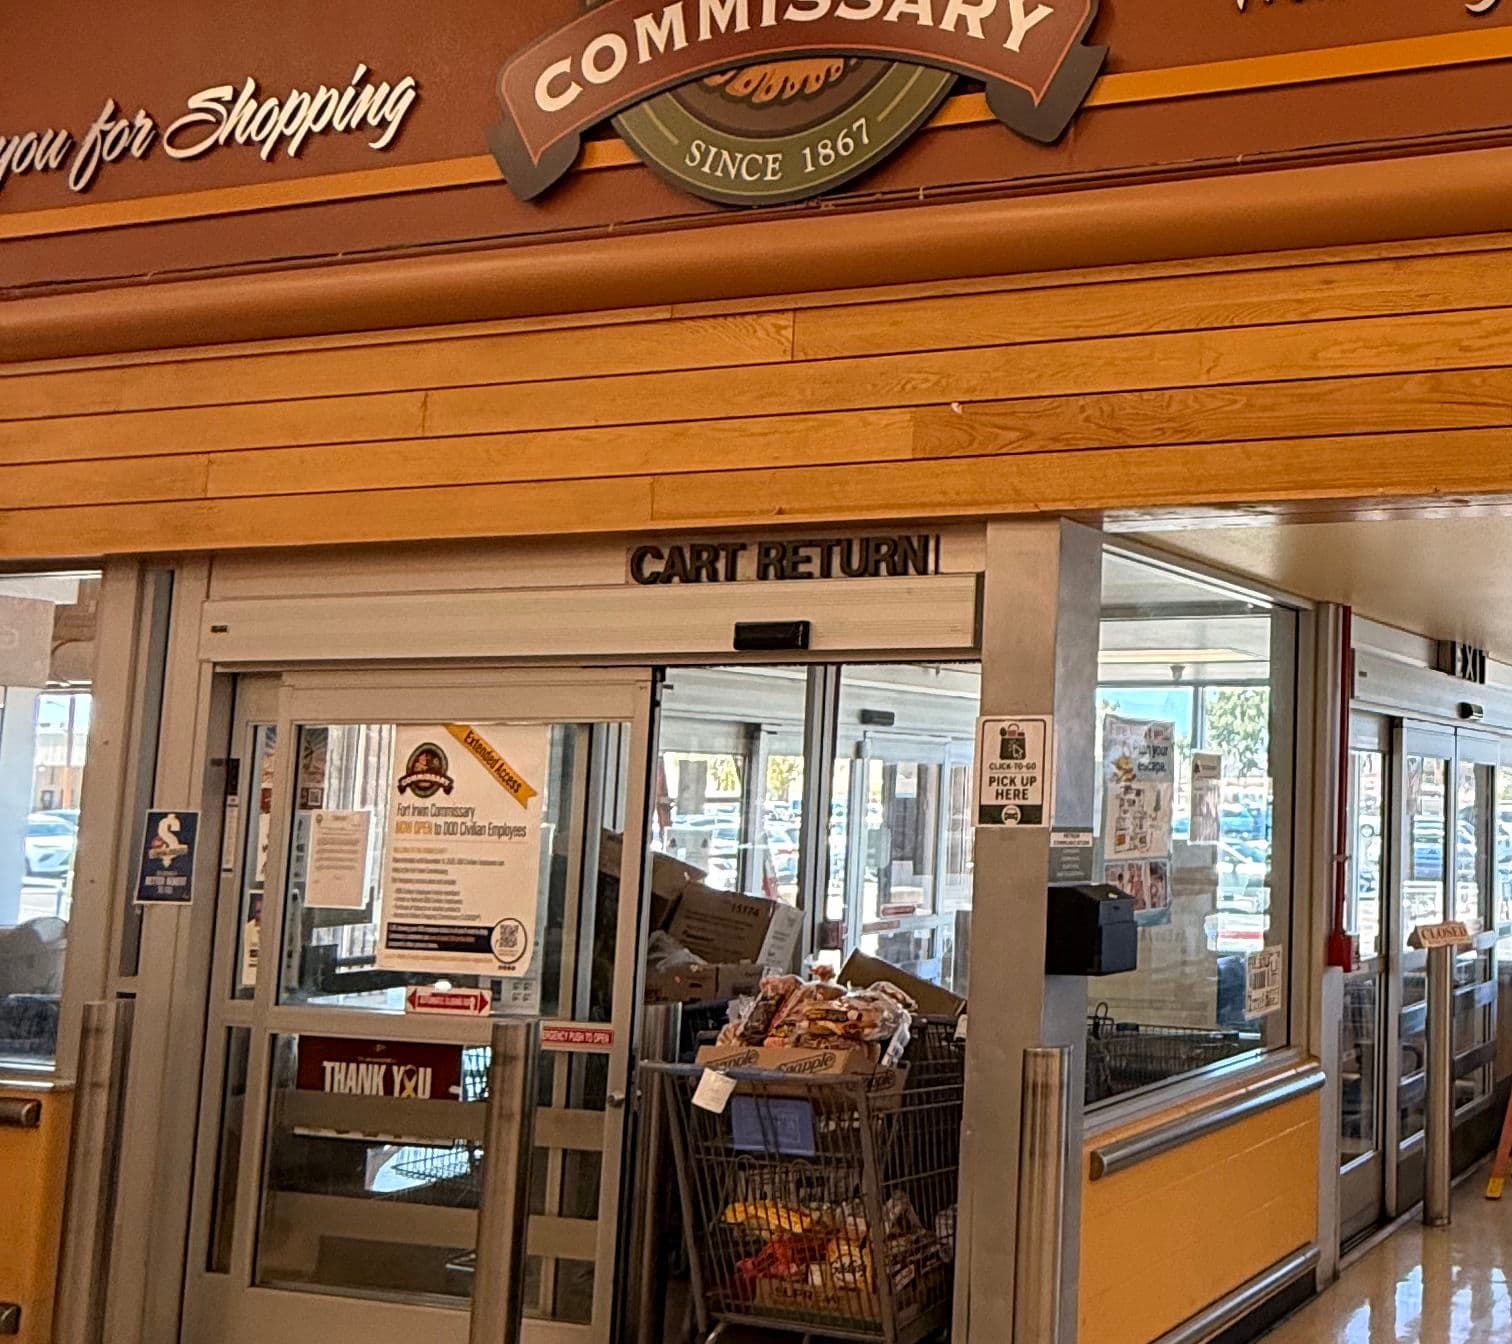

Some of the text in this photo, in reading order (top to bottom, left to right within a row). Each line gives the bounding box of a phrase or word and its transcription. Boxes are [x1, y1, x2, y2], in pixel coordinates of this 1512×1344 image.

[0, 63, 416, 192] you for Shopping
[685, 117, 872, 182] SINCE 1867
[630, 534, 930, 584] CART RETURN
[464, 730, 521, 793] Extended Access
[989, 776, 1037, 787] PICK UP
[995, 789, 1029, 801] HERE
[1421, 927, 1467, 940] CLOSED
[322, 1061, 386, 1097] THANK
